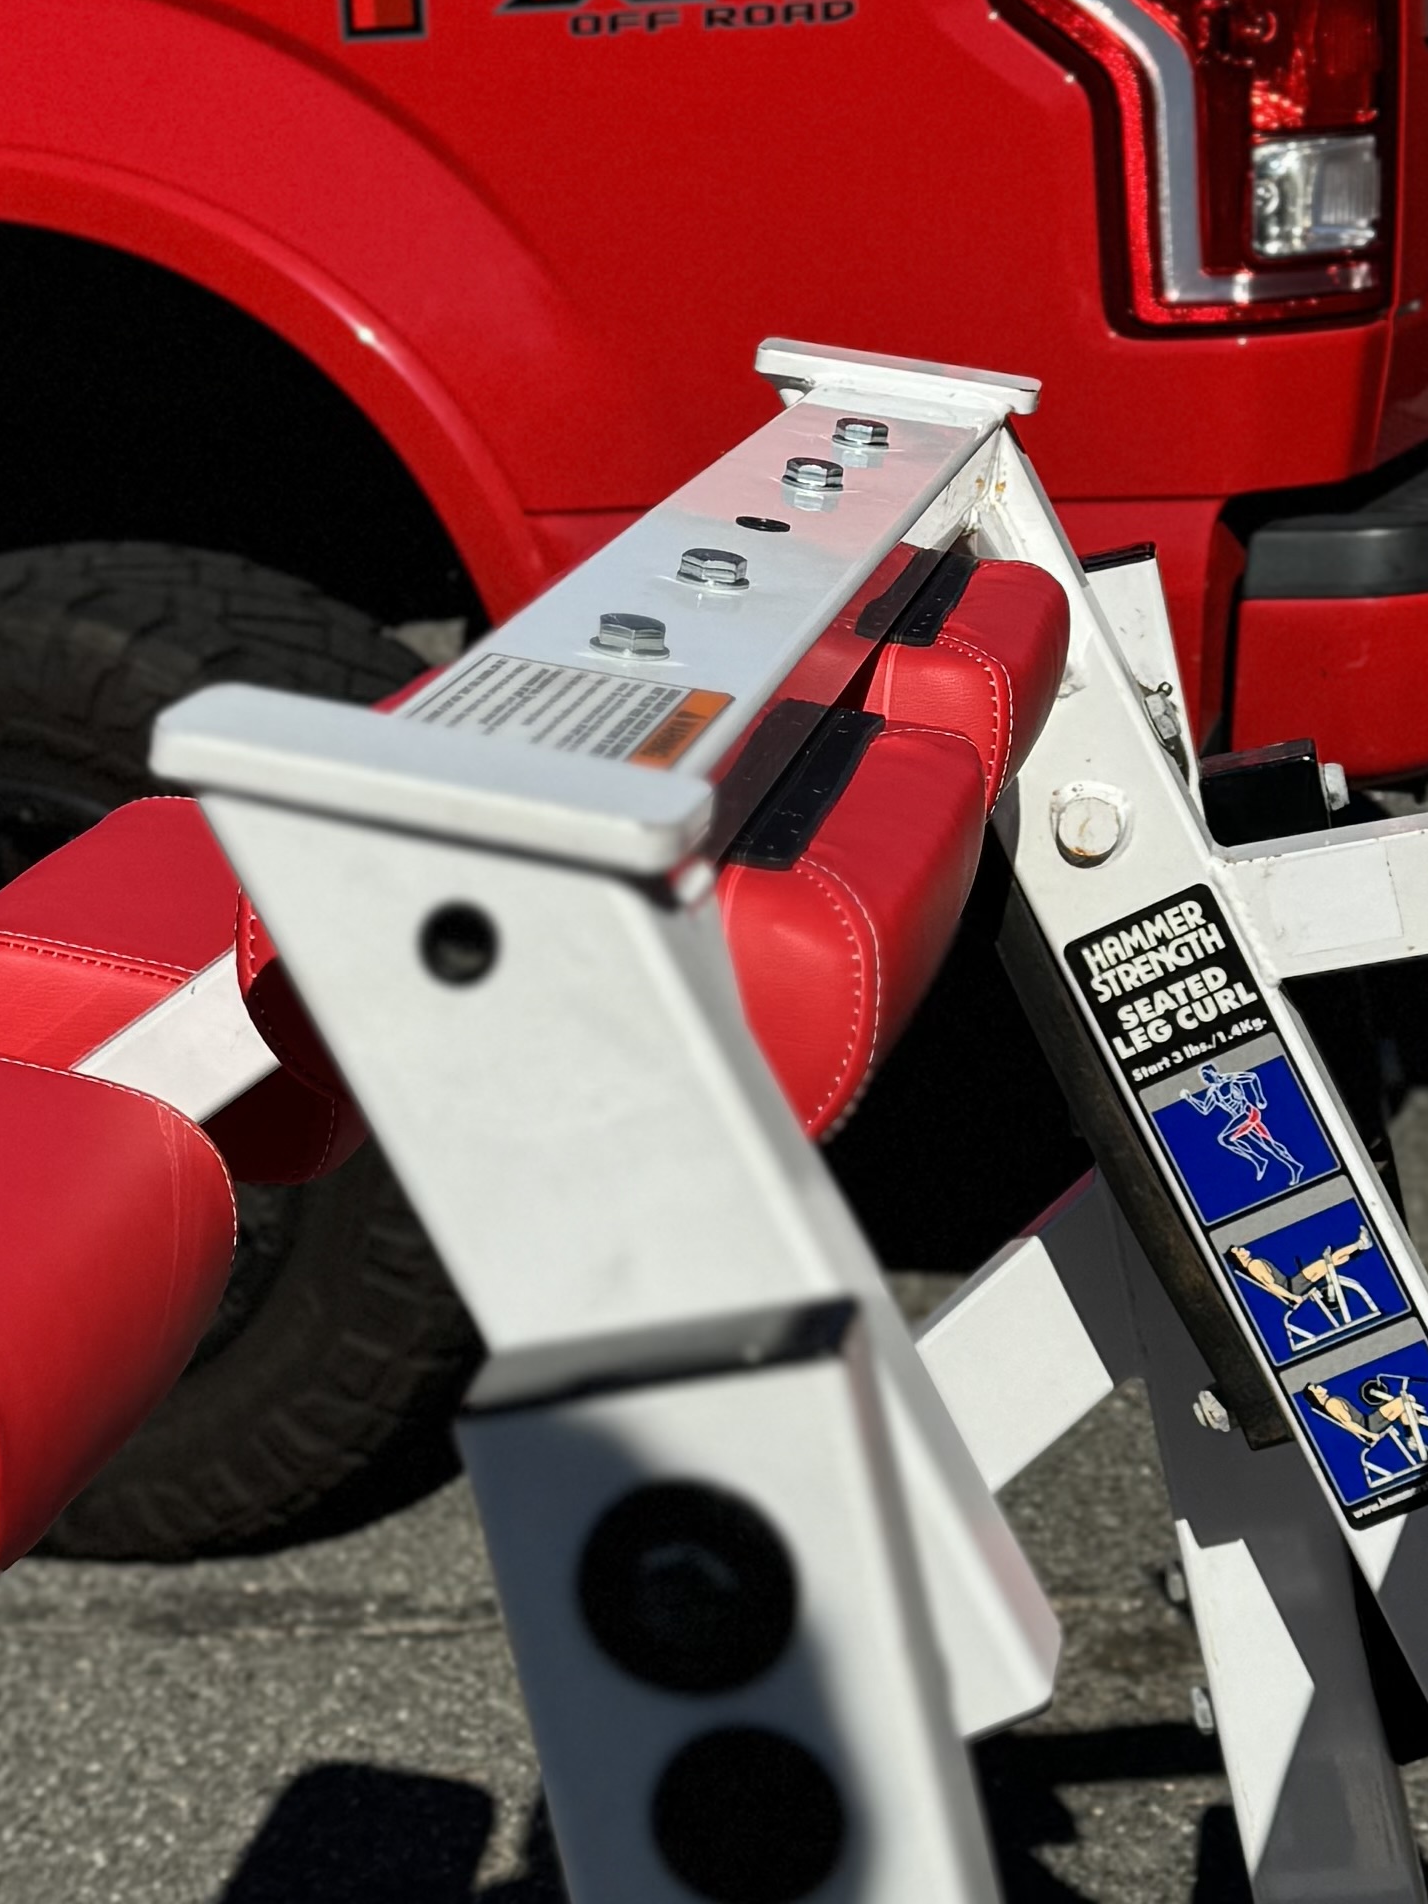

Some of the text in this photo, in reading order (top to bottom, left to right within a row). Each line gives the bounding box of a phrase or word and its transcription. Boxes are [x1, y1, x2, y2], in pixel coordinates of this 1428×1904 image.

[570, 11, 680, 37] OFF
[1082, 900, 1207, 975] HAMMER
[1090, 923, 1226, 1003] STRENGTH
[1112, 981, 1258, 1060] LEG CURL
[1117, 966, 1228, 1030] SEATED
[1131, 1055, 1170, 1082] Start
[1170, 1049, 1184, 1064] 3
